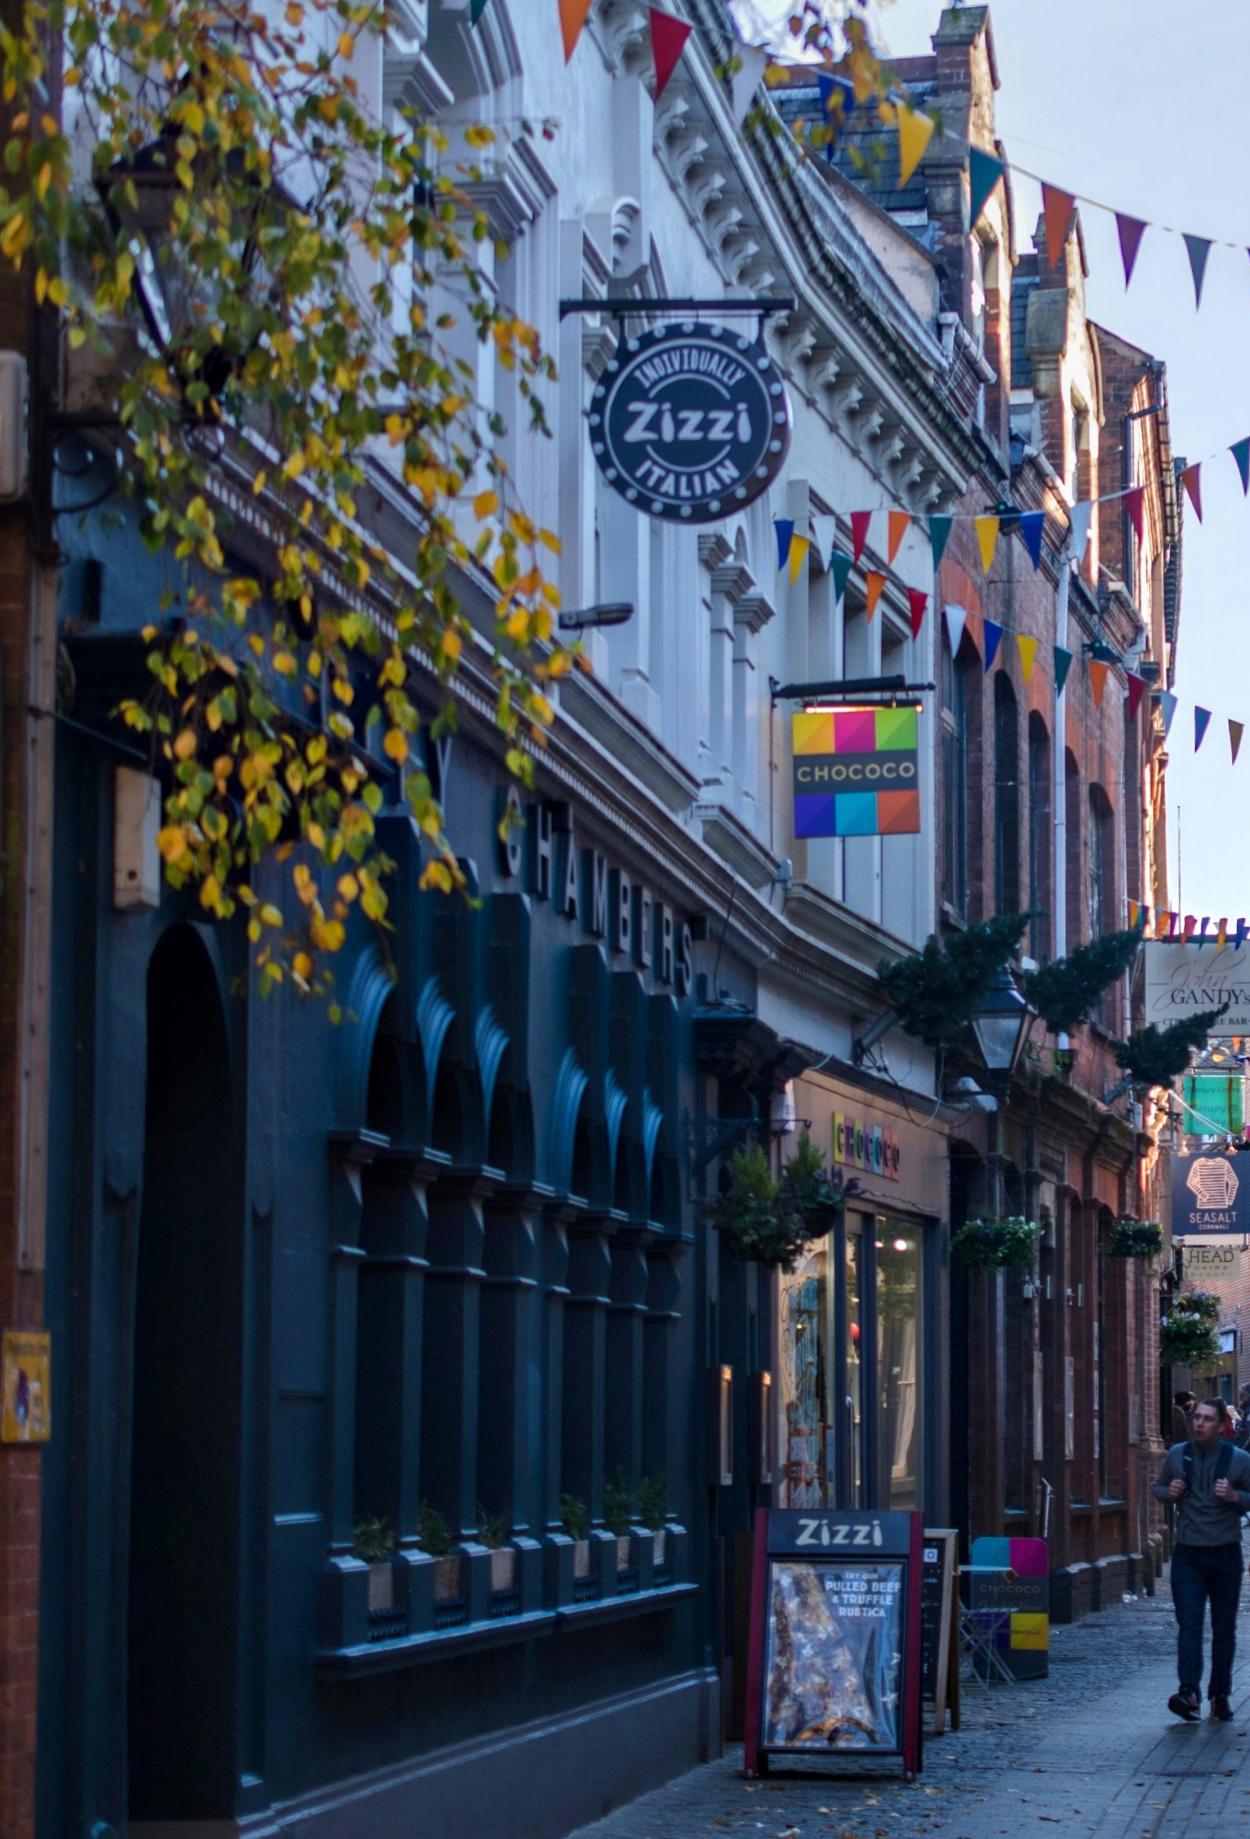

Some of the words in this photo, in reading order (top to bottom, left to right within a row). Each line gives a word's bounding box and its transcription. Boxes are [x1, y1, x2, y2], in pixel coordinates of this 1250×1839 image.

[634, 348, 746, 388] INDIVIDUALLY
[623, 401, 752, 443] Zizzi
[635, 459, 740, 497] ITALIAN
[797, 762, 915, 782] CHOCOCO
[1189, 1211, 1238, 1223] SEASALT
[1190, 1250, 1234, 1263] HEAD
[795, 1518, 883, 1547] Zizzi
[825, 1581, 868, 1592] PULLED
[872, 1582, 902, 1593] BEEF
[842, 1594, 894, 1605] TRUFFLE
[839, 1607, 886, 1617] RUSTICA
